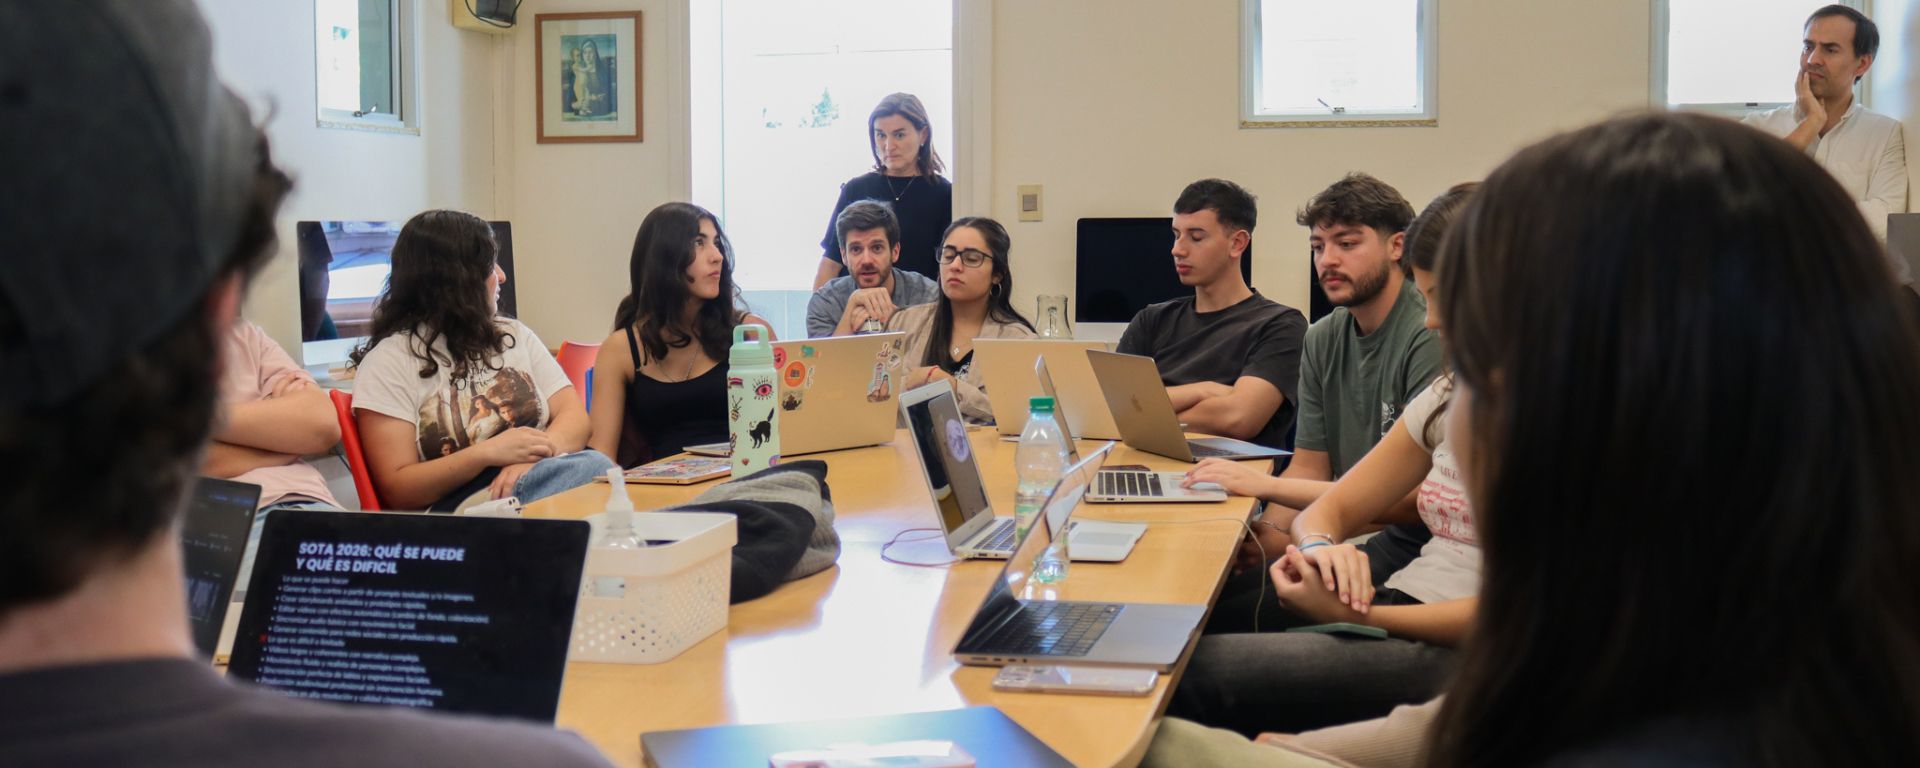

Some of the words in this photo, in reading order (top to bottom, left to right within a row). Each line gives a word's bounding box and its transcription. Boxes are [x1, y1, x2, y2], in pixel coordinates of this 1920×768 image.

[299, 543, 334, 555] SOTA
[335, 543, 372, 558] 2026:
[374, 543, 402, 559] QUÉ
[403, 546, 420, 559] SE
[421, 547, 465, 561] PUEDE
[296, 558, 306, 569] Y
[306, 557, 334, 572] QUÉ
[334, 559, 351, 571] ES
[352, 560, 397, 574] DIFICIL
